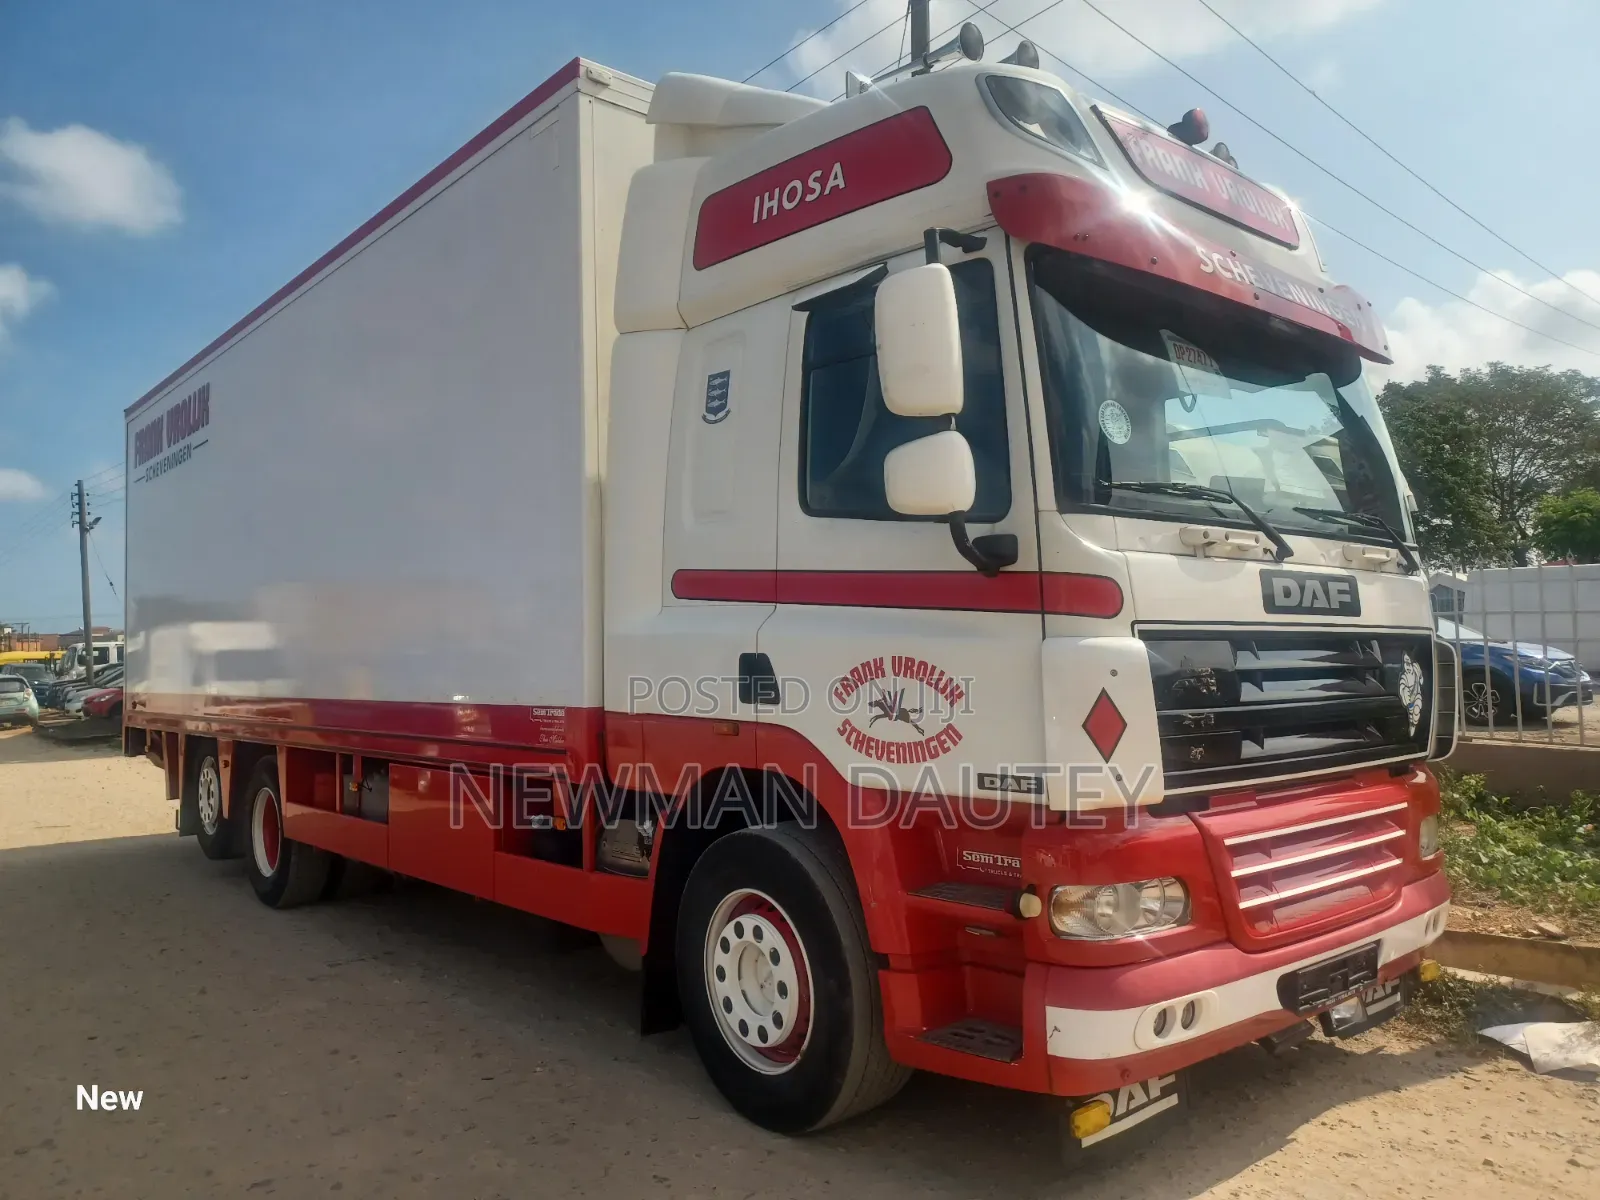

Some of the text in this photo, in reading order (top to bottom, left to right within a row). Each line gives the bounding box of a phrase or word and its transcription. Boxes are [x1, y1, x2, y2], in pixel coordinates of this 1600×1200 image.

[752, 162, 846, 224] IHOSA
[145, 441, 192, 483] SCHEVENINGEN
[1272, 577, 1352, 609] DAF
[833, 656, 886, 706] FRANK
[837, 718, 963, 764] SCHEVENINGEN
[983, 776, 1038, 791] DAF
